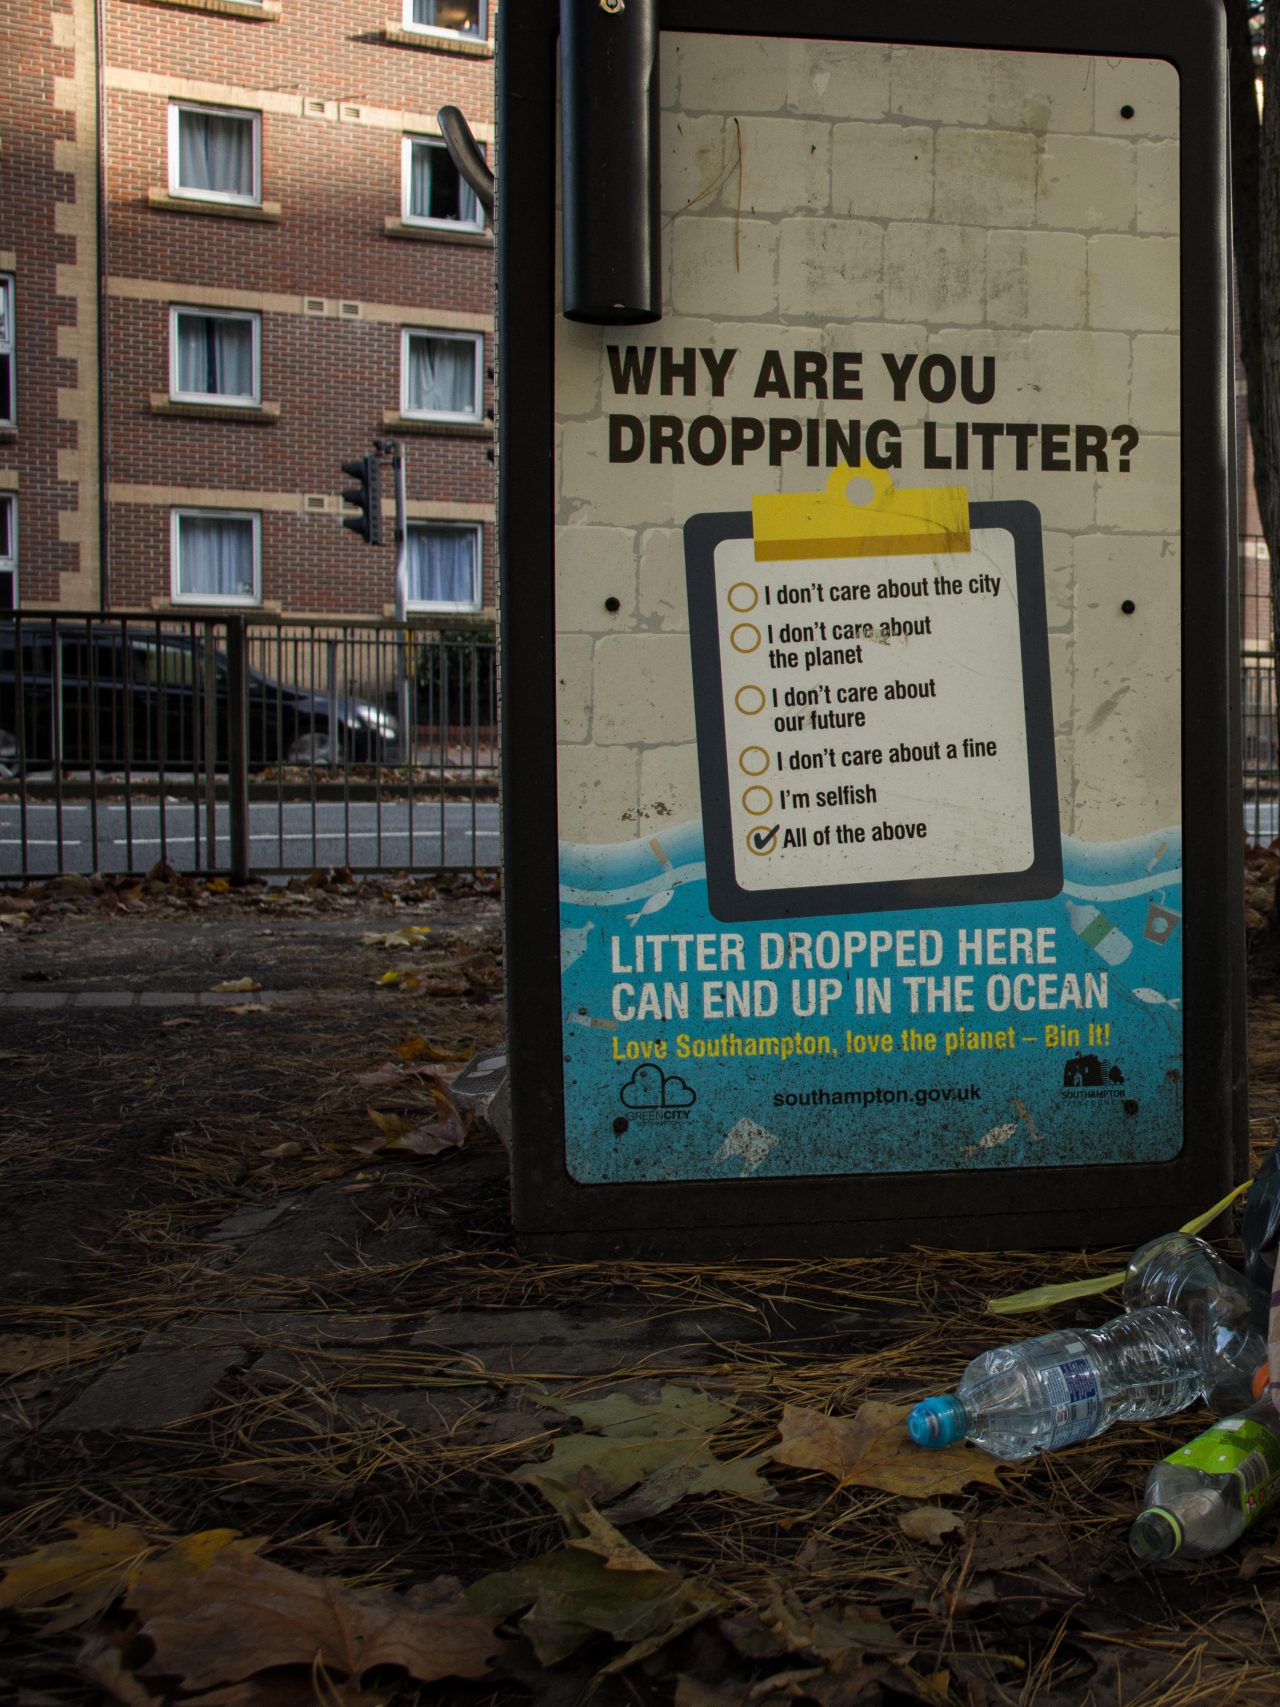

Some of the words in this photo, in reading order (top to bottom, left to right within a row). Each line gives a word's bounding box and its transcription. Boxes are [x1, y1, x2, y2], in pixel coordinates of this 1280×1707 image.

[606, 345, 738, 397] WHY
[753, 349, 864, 401] ARE
[880, 352, 996, 405] YOU
[608, 413, 902, 470] DROPPING
[923, 421, 1140, 473] LITTER?
[764, 585, 771, 606] I
[776, 582, 825, 605] don't
[829, 584, 871, 602] care
[876, 577, 930, 599] about
[933, 575, 963, 596] the
[968, 573, 1001, 597] city
[767, 624, 774, 644] I
[779, 621, 827, 644] don't
[832, 622, 874, 641] care
[879, 615, 932, 638] about
[768, 648, 799, 669] the
[804, 644, 864, 671] planet
[772, 687, 778, 708] I
[784, 684, 832, 707] don't
[836, 685, 878, 704] care
[884, 678, 937, 701] about
[774, 715, 805, 733] our
[810, 709, 866, 730] future
[777, 751, 783, 772] I
[789, 748, 837, 771] don't
[841, 748, 883, 767] care
[888, 741, 941, 764] about
[946, 743, 958, 760] a
[962, 738, 997, 758] fine
[780, 789, 810, 810] I'm
[815, 783, 877, 808] selfish
[782, 827, 807, 849] All
[813, 825, 831, 847] of
[835, 824, 866, 845] the
[871, 821, 927, 842] above
[611, 933, 746, 974] LITTER
[760, 929, 944, 970] DROPPED
[958, 927, 1057, 966] HERE
[611, 981, 689, 1022] CAN
[702, 979, 778, 1019] END
[791, 978, 843, 1017] UP
[855, 977, 892, 1015] IN
[902, 975, 975, 1014] THE
[986, 971, 1108, 1012] OCEAN
[612, 1036, 668, 1060] Love
[675, 1032, 838, 1061] Southampton,
[846, 1029, 894, 1054] love
[901, 1028, 937, 1052] the
[945, 1026, 1015, 1056] planet
[1045, 1024, 1080, 1048] Bin
[1088, 1023, 1111, 1047] It!
[772, 1083, 982, 1109] southampton.gov.uk
[1061, 1089, 1126, 1099] SOUTHAMPTON
